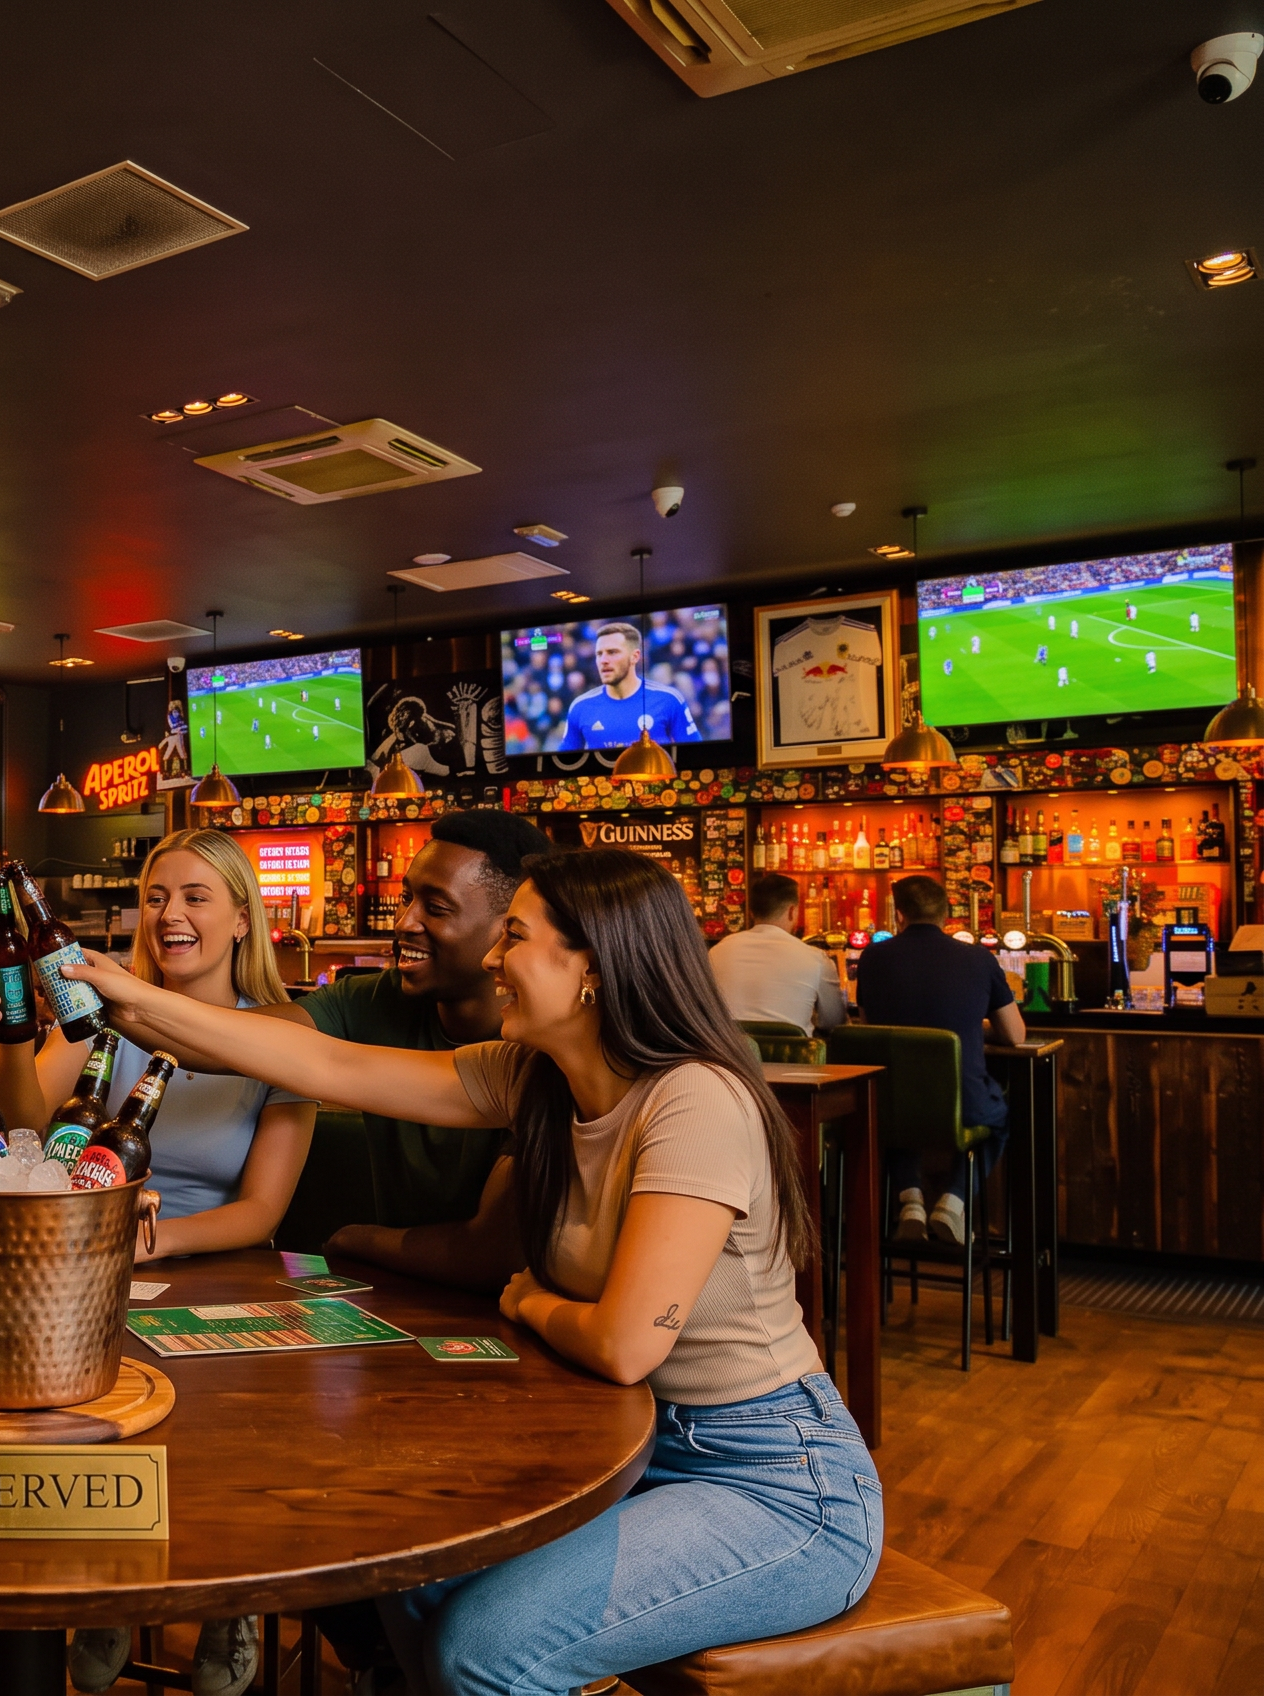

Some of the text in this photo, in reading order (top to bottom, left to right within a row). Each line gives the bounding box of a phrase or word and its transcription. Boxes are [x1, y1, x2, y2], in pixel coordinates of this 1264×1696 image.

[83, 747, 160, 796] APEROL
[99, 775, 149, 811] SPRITZ
[600, 823, 694, 843] GUINNESS
